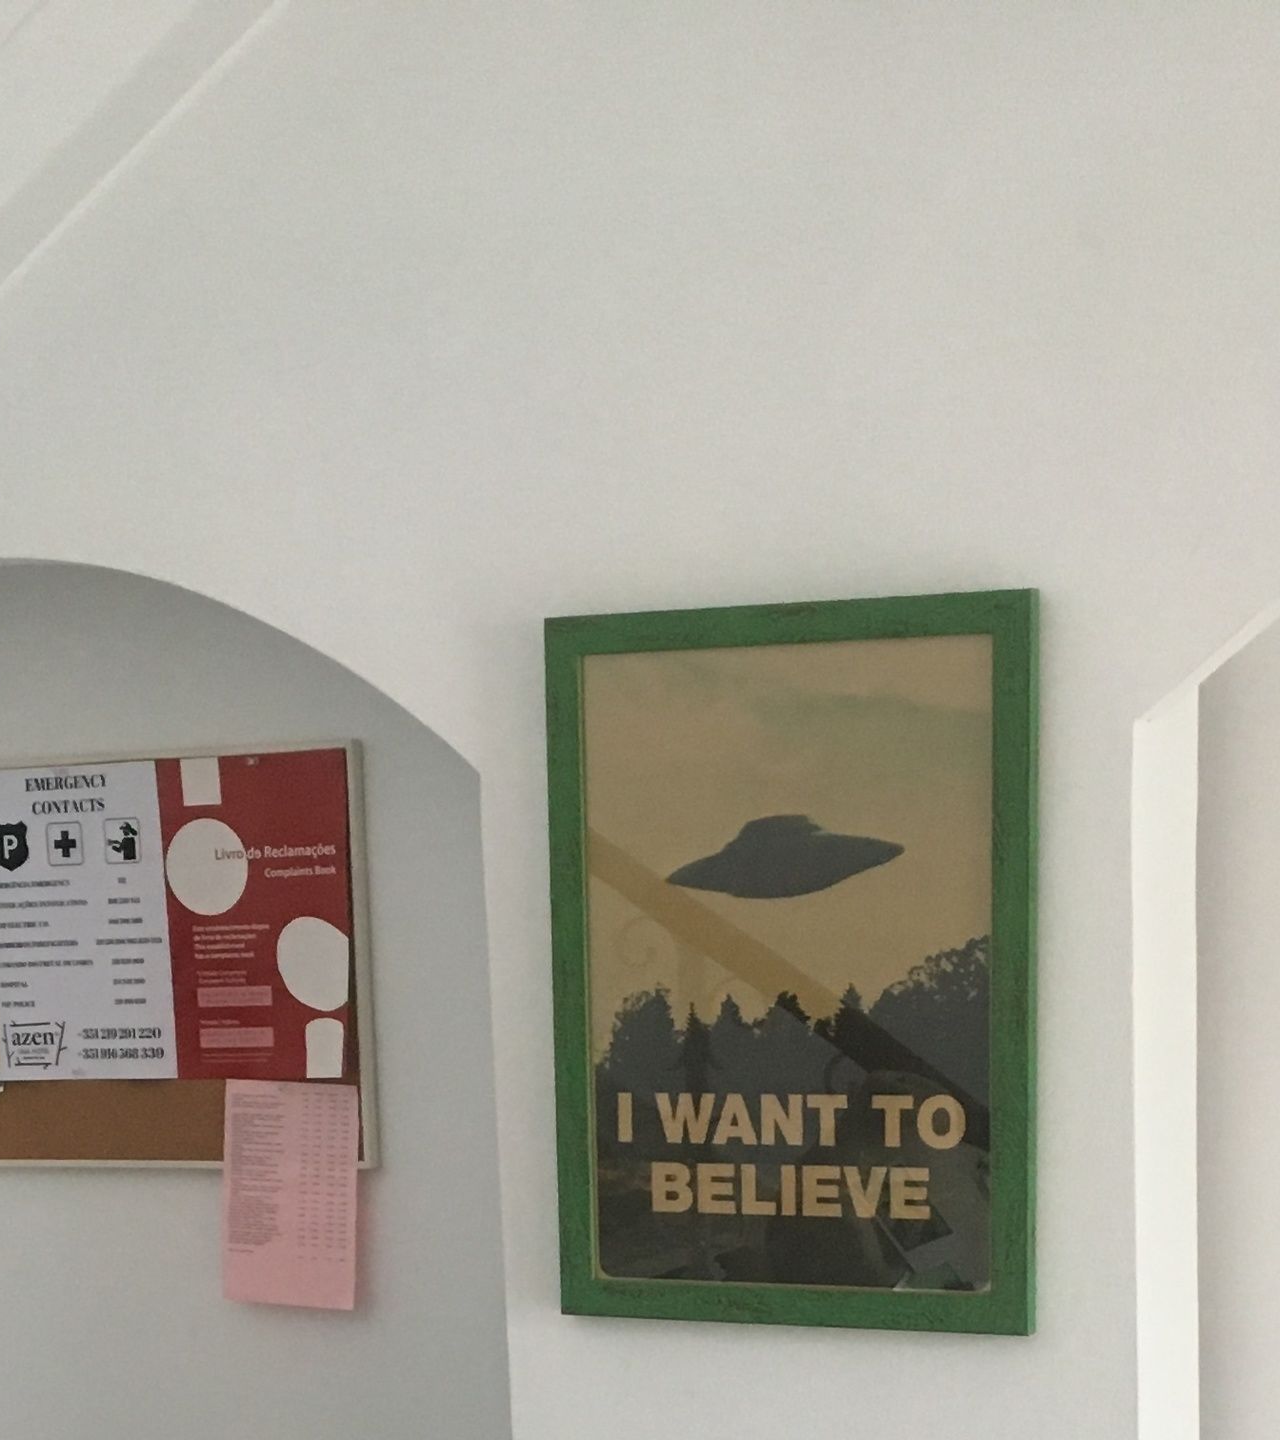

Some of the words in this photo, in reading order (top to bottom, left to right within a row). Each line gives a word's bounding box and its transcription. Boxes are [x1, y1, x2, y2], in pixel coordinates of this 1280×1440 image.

[24, 774, 107, 792] EMERGENCY
[31, 798, 106, 815] CONTACTS
[214, 848, 244, 861] Livro
[246, 847, 262, 859] de
[264, 844, 337, 859] Reclamações
[264, 867, 313, 878] Complaints
[315, 865, 337, 875] Book
[12, 1031, 55, 1046] azen
[616, 1092, 633, 1143] I
[655, 1092, 848, 1147] WANT
[871, 1094, 966, 1150] TO
[650, 1162, 931, 1220] BELIEVE
